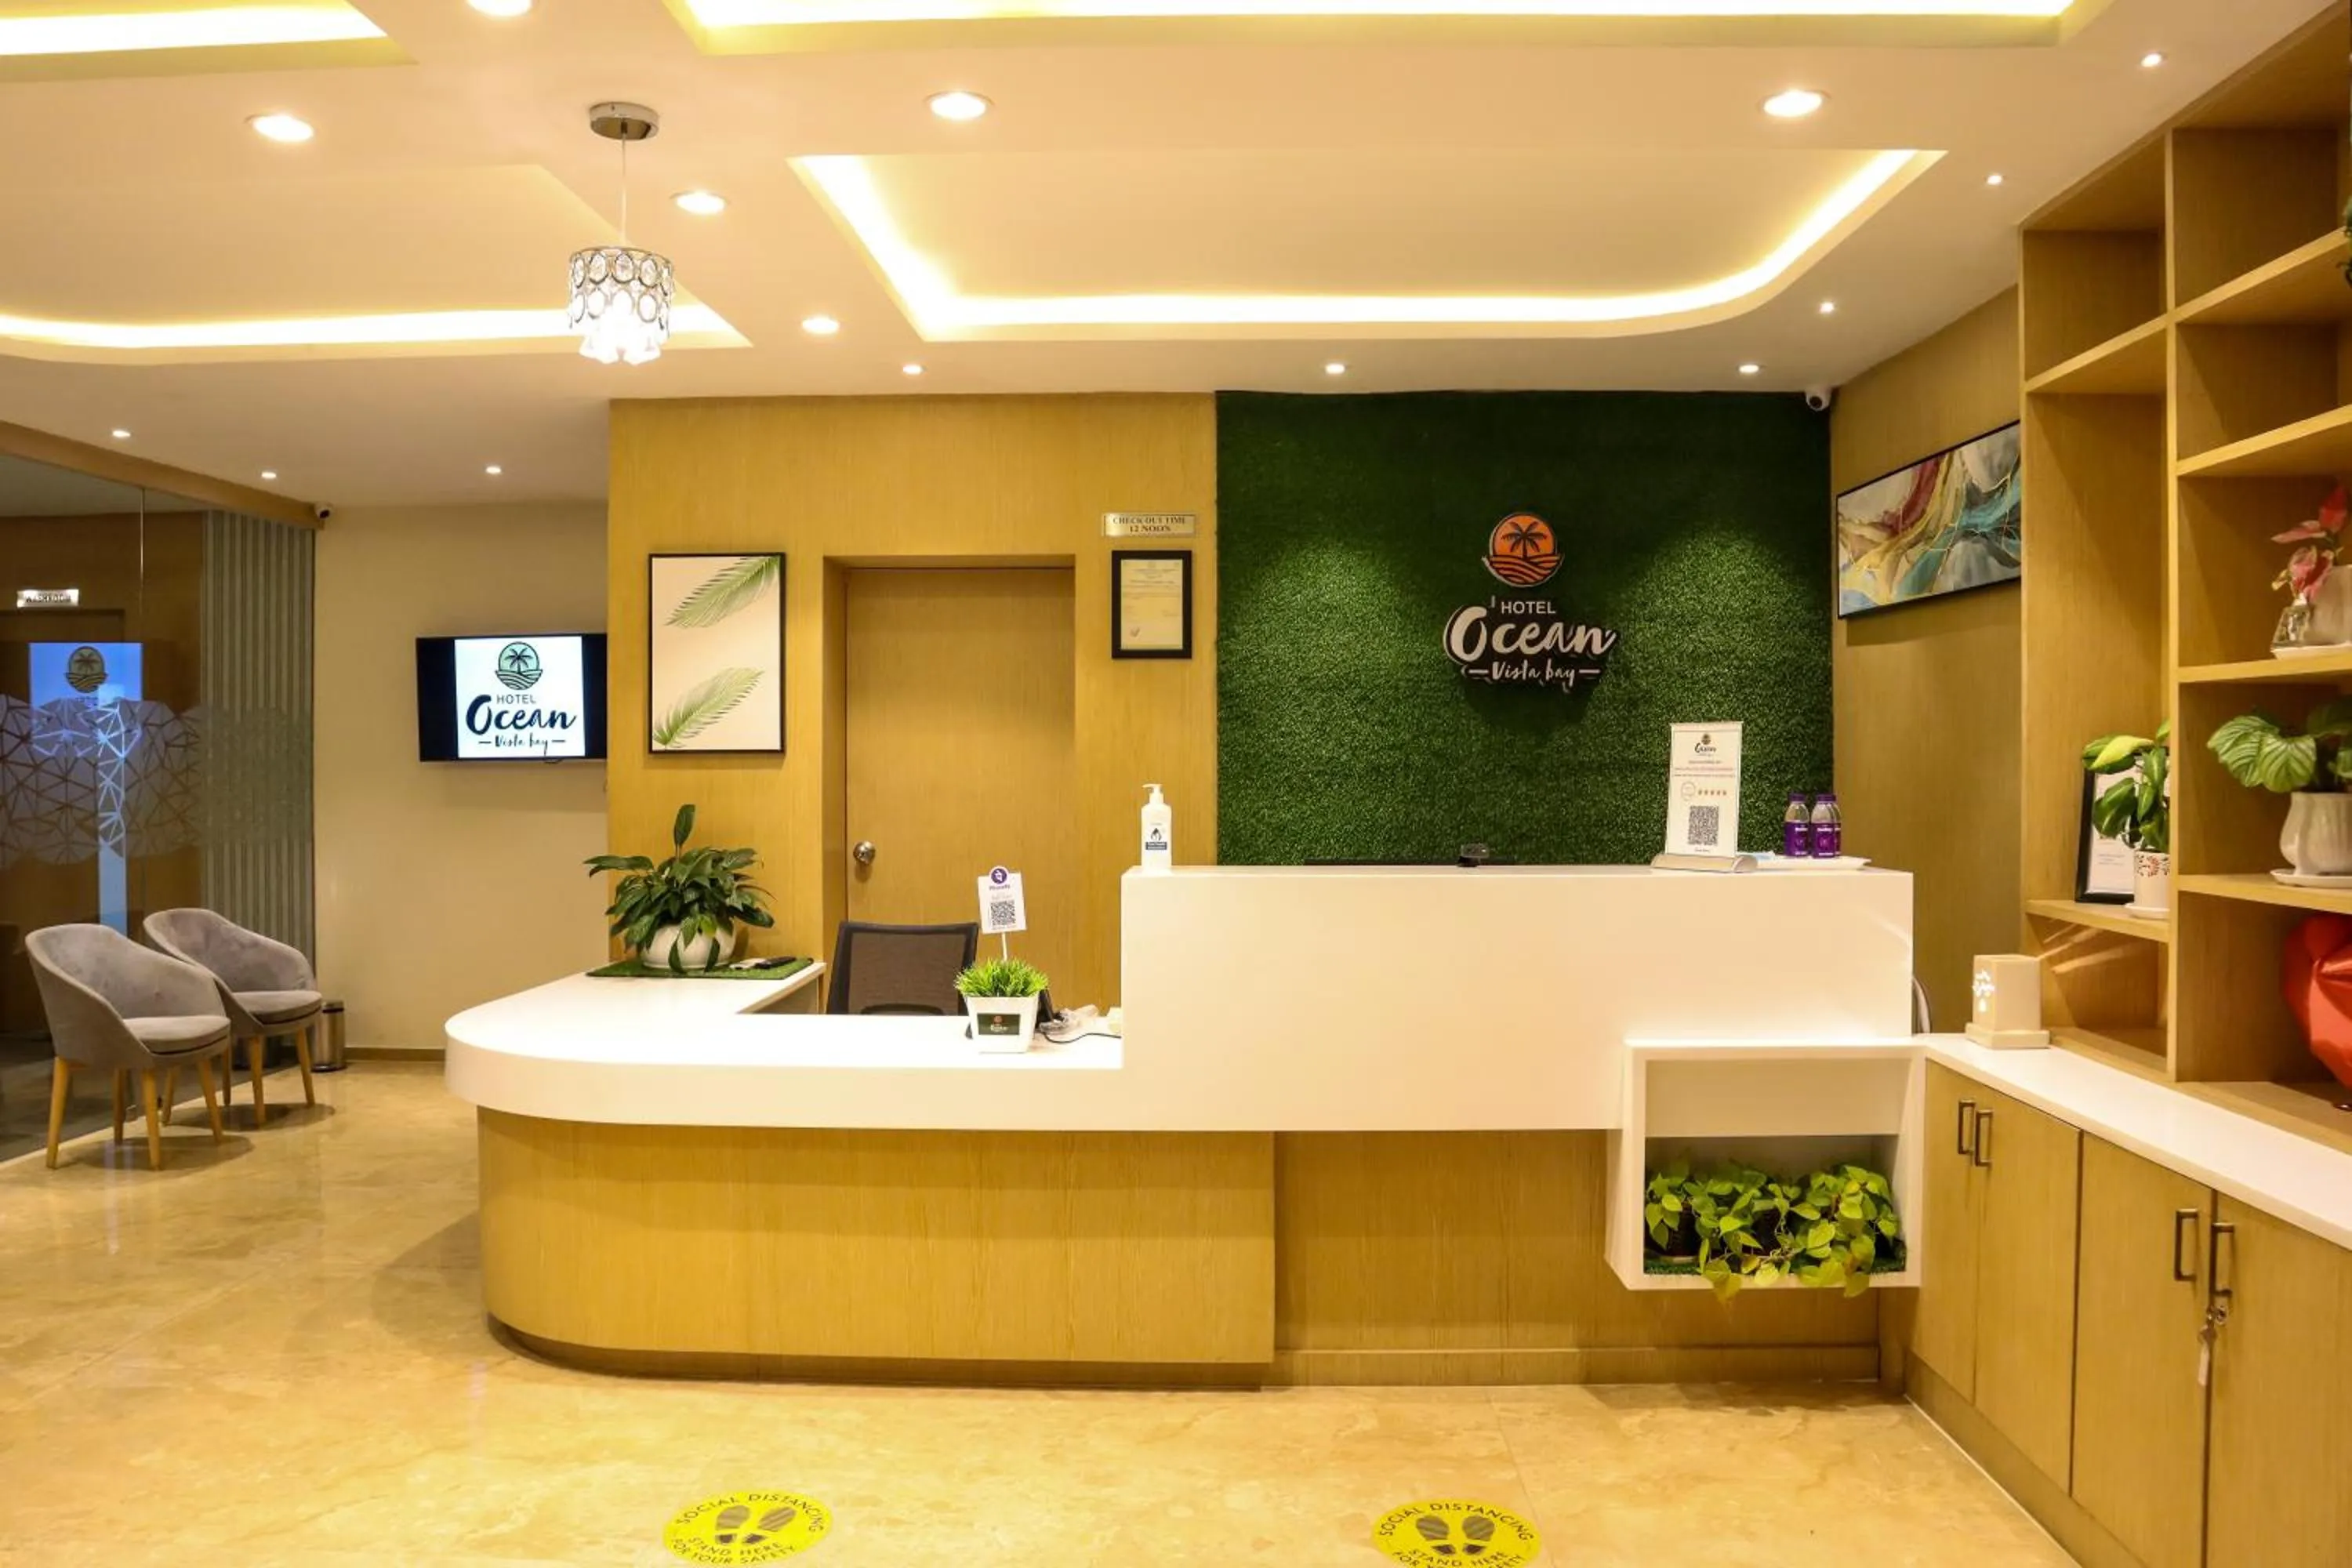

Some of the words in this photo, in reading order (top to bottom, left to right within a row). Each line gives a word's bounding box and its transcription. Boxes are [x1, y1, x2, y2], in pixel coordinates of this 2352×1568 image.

[1501, 601, 1556, 615] HOTEL
[1447, 606, 1617, 662] Ocean
[1492, 659, 1540, 681] Vista
[1544, 659, 1575, 688] bay
[496, 694, 536, 705] HOTEL
[466, 694, 577, 735] Ocean
[495, 733, 525, 747] Vista
[529, 732, 548, 757] bay
[677, 1497, 739, 1524] SOCIAL
[748, 1494, 823, 1532] DISTANCING
[1379, 1506, 1424, 1537] SOCIAL
[1429, 1503, 1534, 1541] DISTANCING
[1408, 1549, 1462, 1567] STAND
